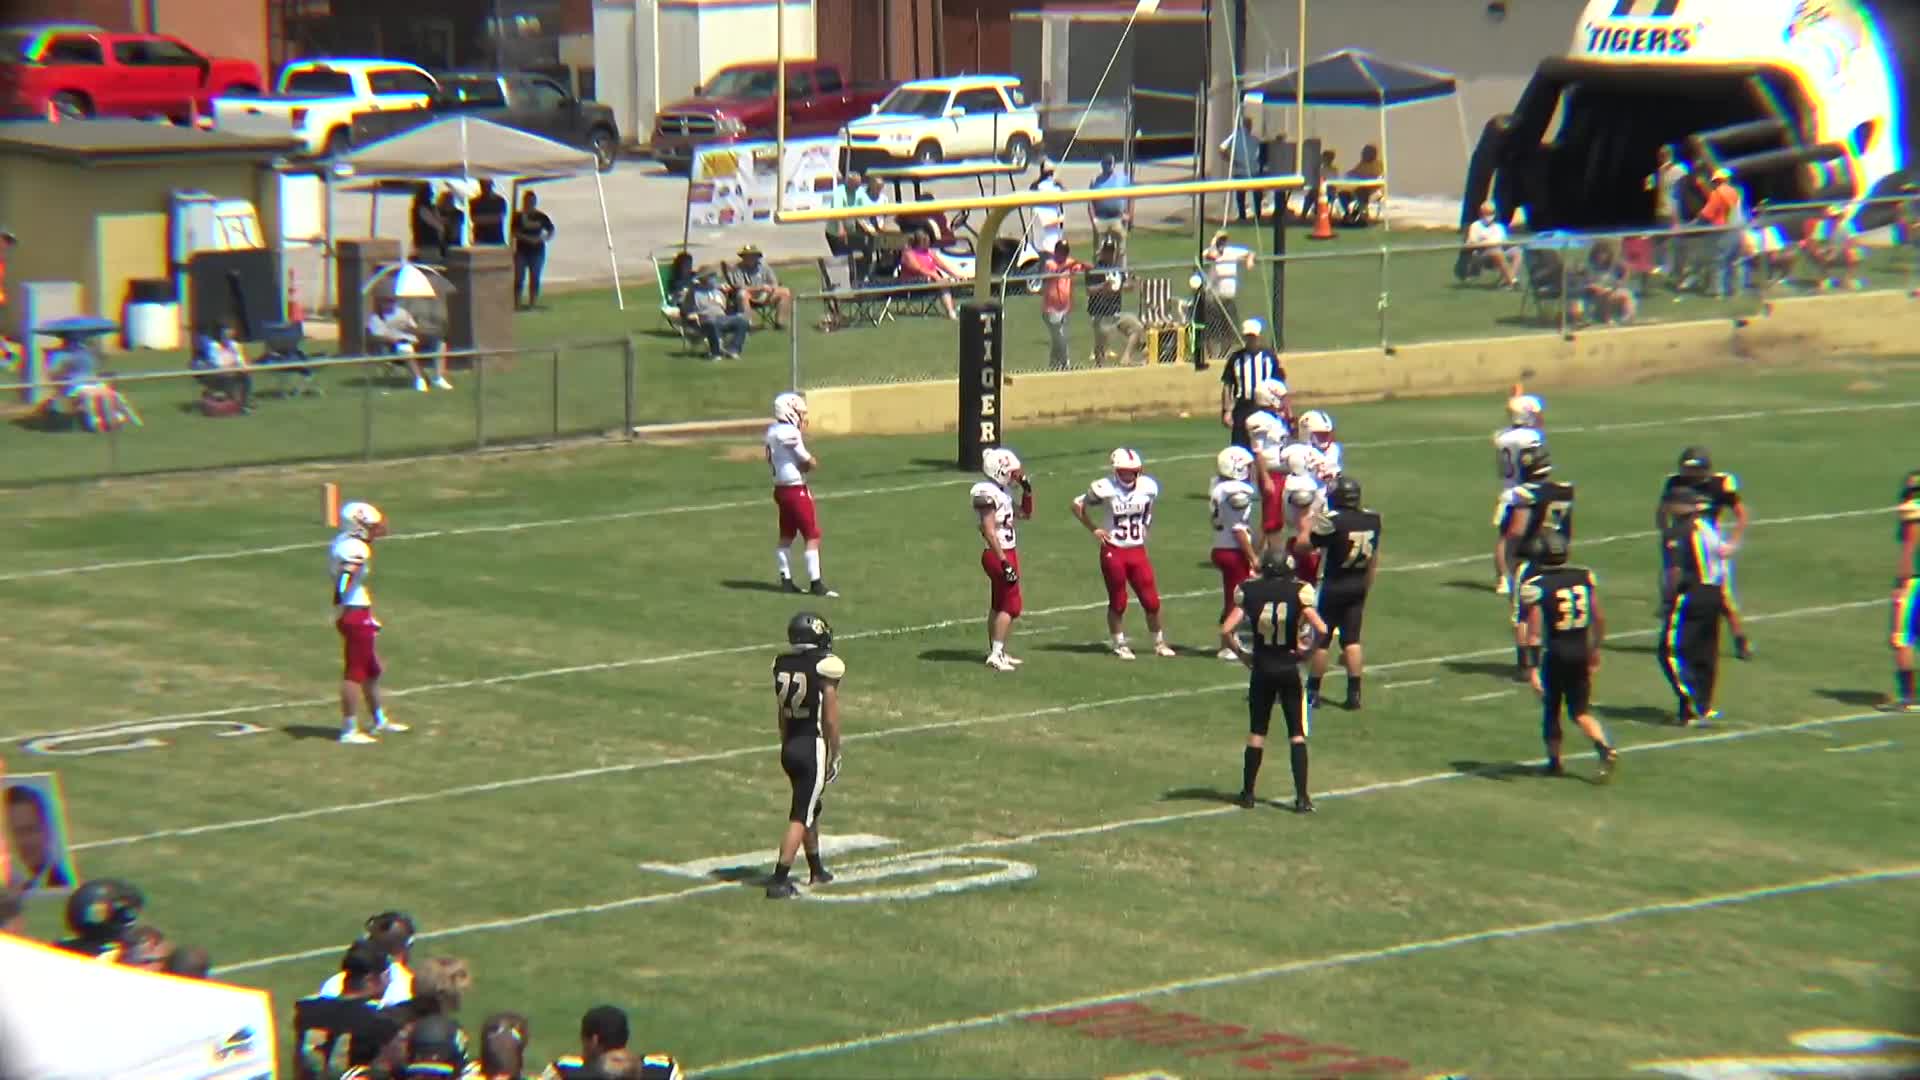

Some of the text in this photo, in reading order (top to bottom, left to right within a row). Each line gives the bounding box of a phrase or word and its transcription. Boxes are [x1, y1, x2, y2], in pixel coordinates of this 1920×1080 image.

[1588, 27, 1691, 52] TIGERS
[980, 313, 997, 457] TIGER
[1257, 601, 1288, 646] 41
[1555, 585, 1591, 631] 33
